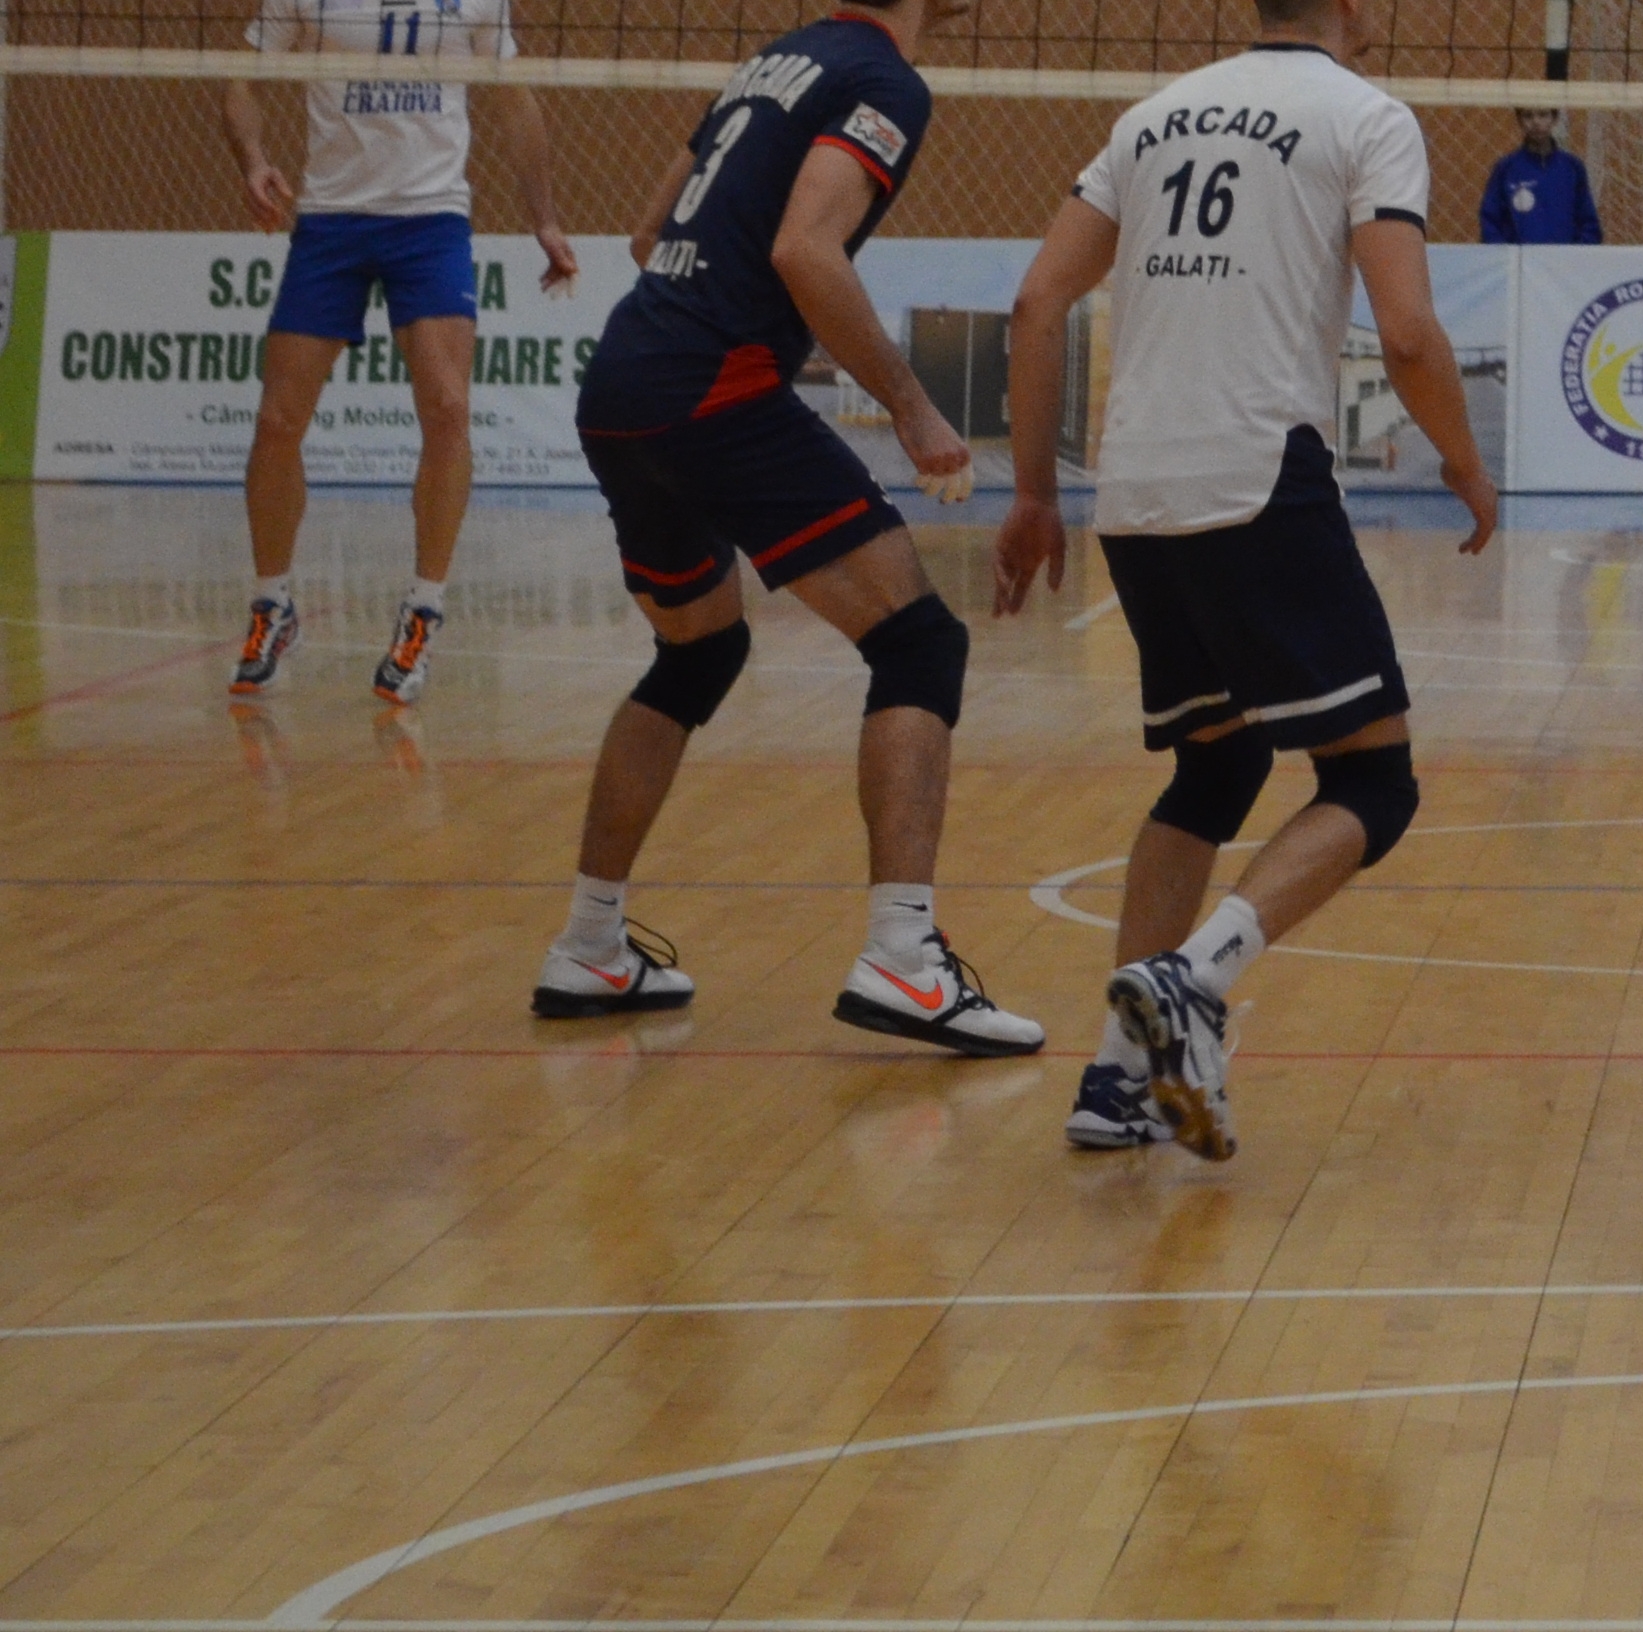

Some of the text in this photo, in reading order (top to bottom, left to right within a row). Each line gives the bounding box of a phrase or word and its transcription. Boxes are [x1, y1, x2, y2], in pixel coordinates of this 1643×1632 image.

[672, 105, 752, 225] 3
[1134, 105, 1304, 166] ARCADA
[1161, 158, 1241, 238] 16
[1145, 254, 1231, 285] GALAȚI
